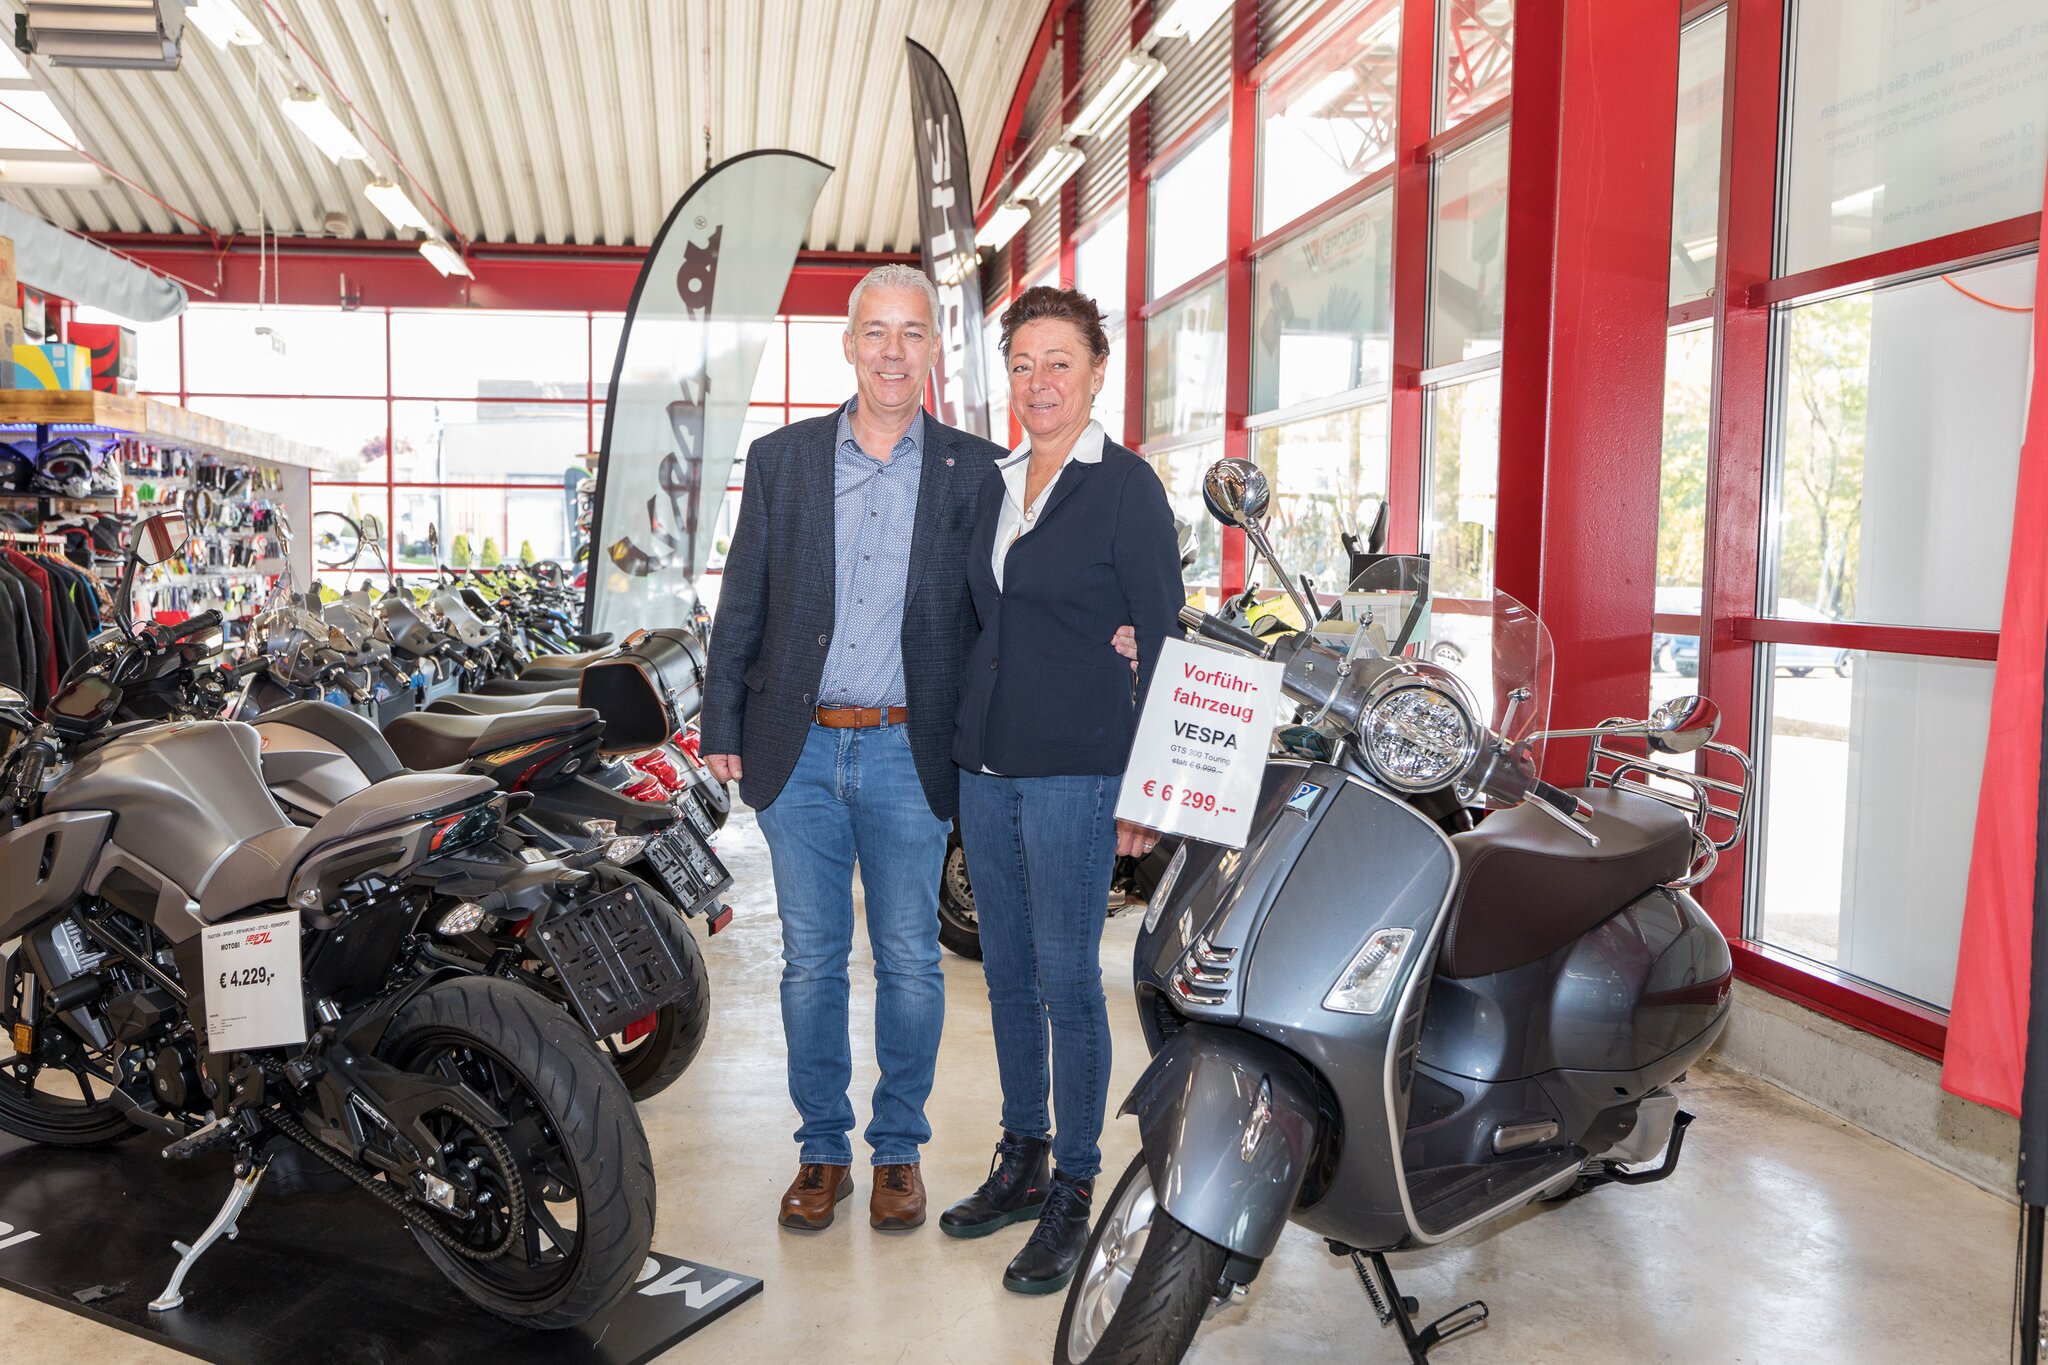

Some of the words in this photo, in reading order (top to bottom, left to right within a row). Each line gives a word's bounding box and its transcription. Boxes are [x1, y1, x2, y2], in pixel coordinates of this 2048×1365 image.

[1184, 662, 1258, 693] Vorführ-
[1173, 687, 1254, 723] fahrzeug
[1174, 720, 1238, 750] VESPA
[1170, 744, 1187, 755] GTS
[1204, 752, 1231, 766] Touring
[1143, 780, 1157, 797] €
[220, 941, 241, 951] MOTOBI
[219, 971, 227, 989] €
[230, 966, 275, 987] 4.229,-
